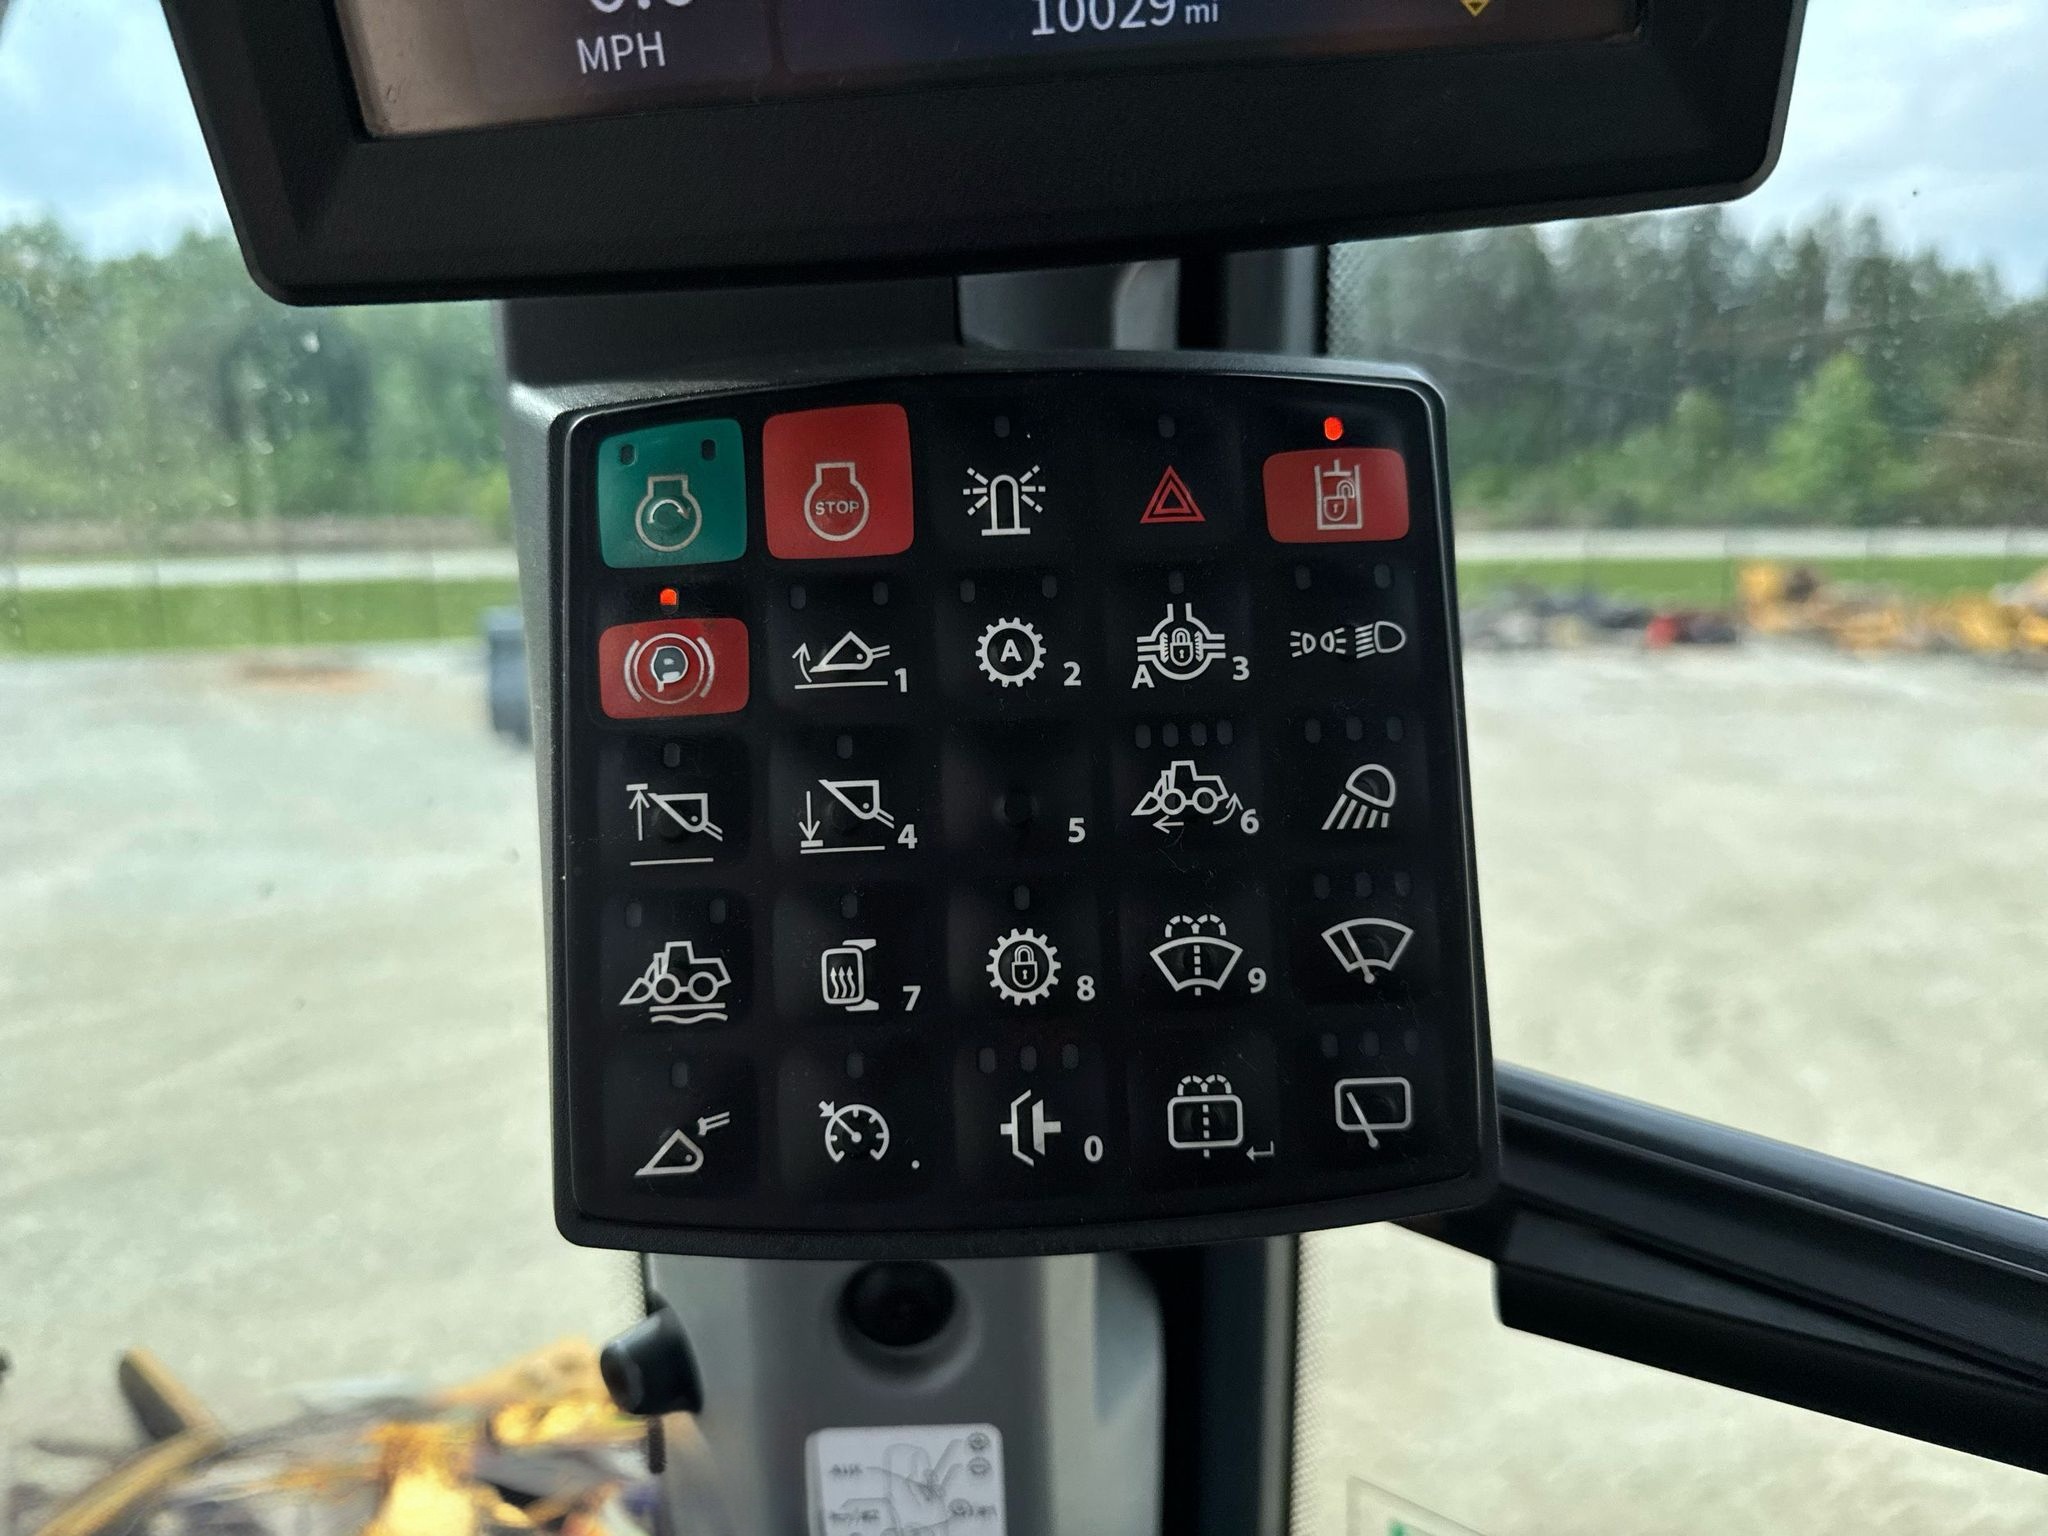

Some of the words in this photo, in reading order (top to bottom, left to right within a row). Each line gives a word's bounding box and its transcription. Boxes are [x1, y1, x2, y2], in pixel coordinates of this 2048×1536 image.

[1031, 0, 1176, 36] 10029
[1185, 0, 1218, 24] mi
[576, 31, 666, 74] MPH
[815, 499, 860, 517] STOP
[999, 638, 1022, 663] A
[894, 667, 908, 693] 1
[1063, 661, 1082, 686] 2
[1131, 664, 1155, 689] A
[1232, 655, 1250, 681] 3
[1068, 817, 1086, 843] 5
[1239, 808, 1260, 834] 6
[897, 823, 918, 849] 4
[1076, 975, 1096, 1001] 8
[1247, 967, 1267, 994] 9
[902, 985, 921, 1011] 7
